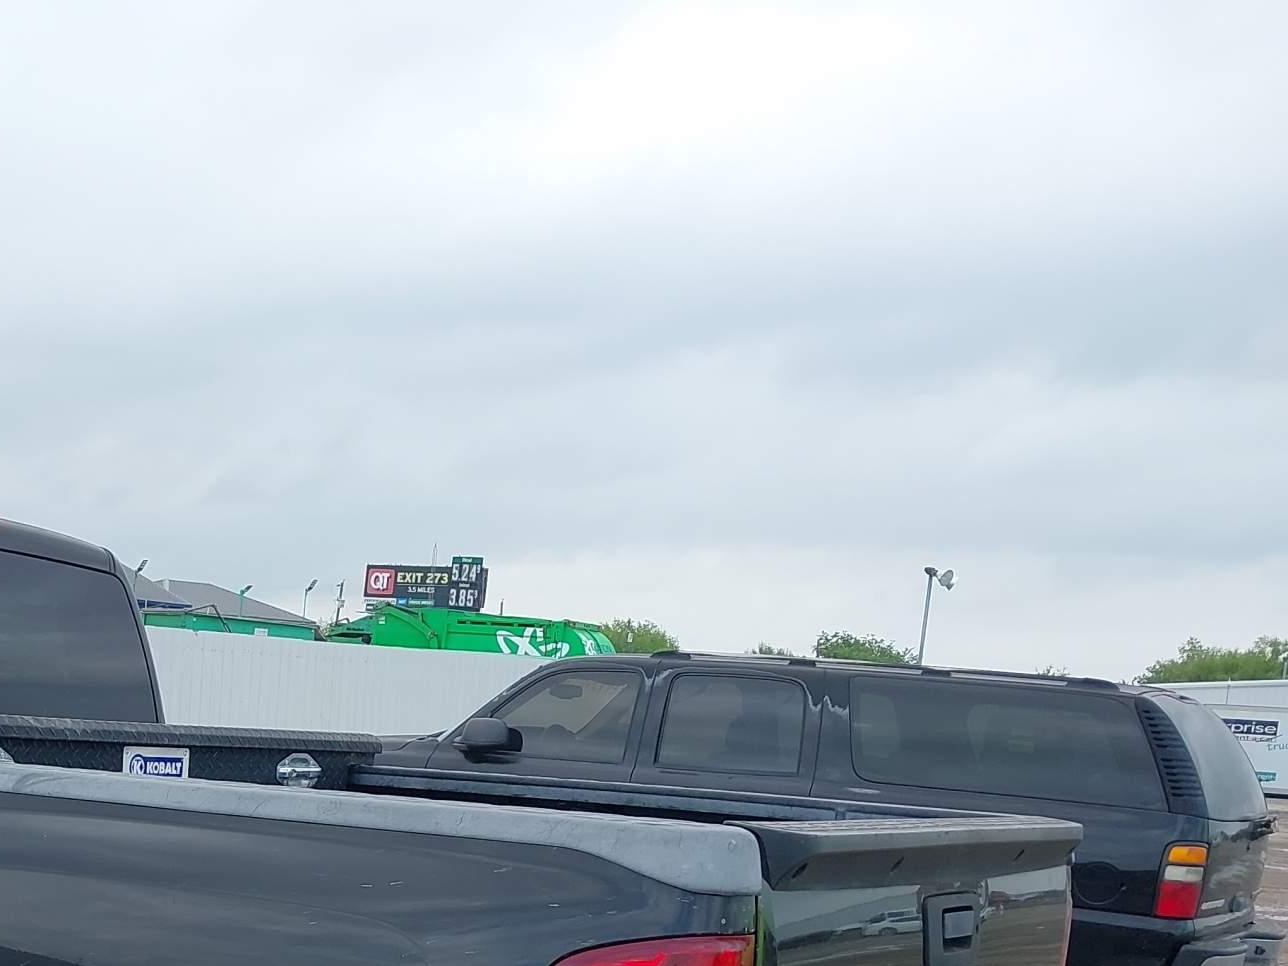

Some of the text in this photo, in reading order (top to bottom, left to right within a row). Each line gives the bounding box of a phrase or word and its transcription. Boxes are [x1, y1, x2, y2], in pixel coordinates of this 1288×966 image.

[370, 572, 391, 590] QT
[397, 572, 449, 584] EXIT 273
[418, 586, 435, 594] MILES
[146, 761, 182, 775] KOBALT
